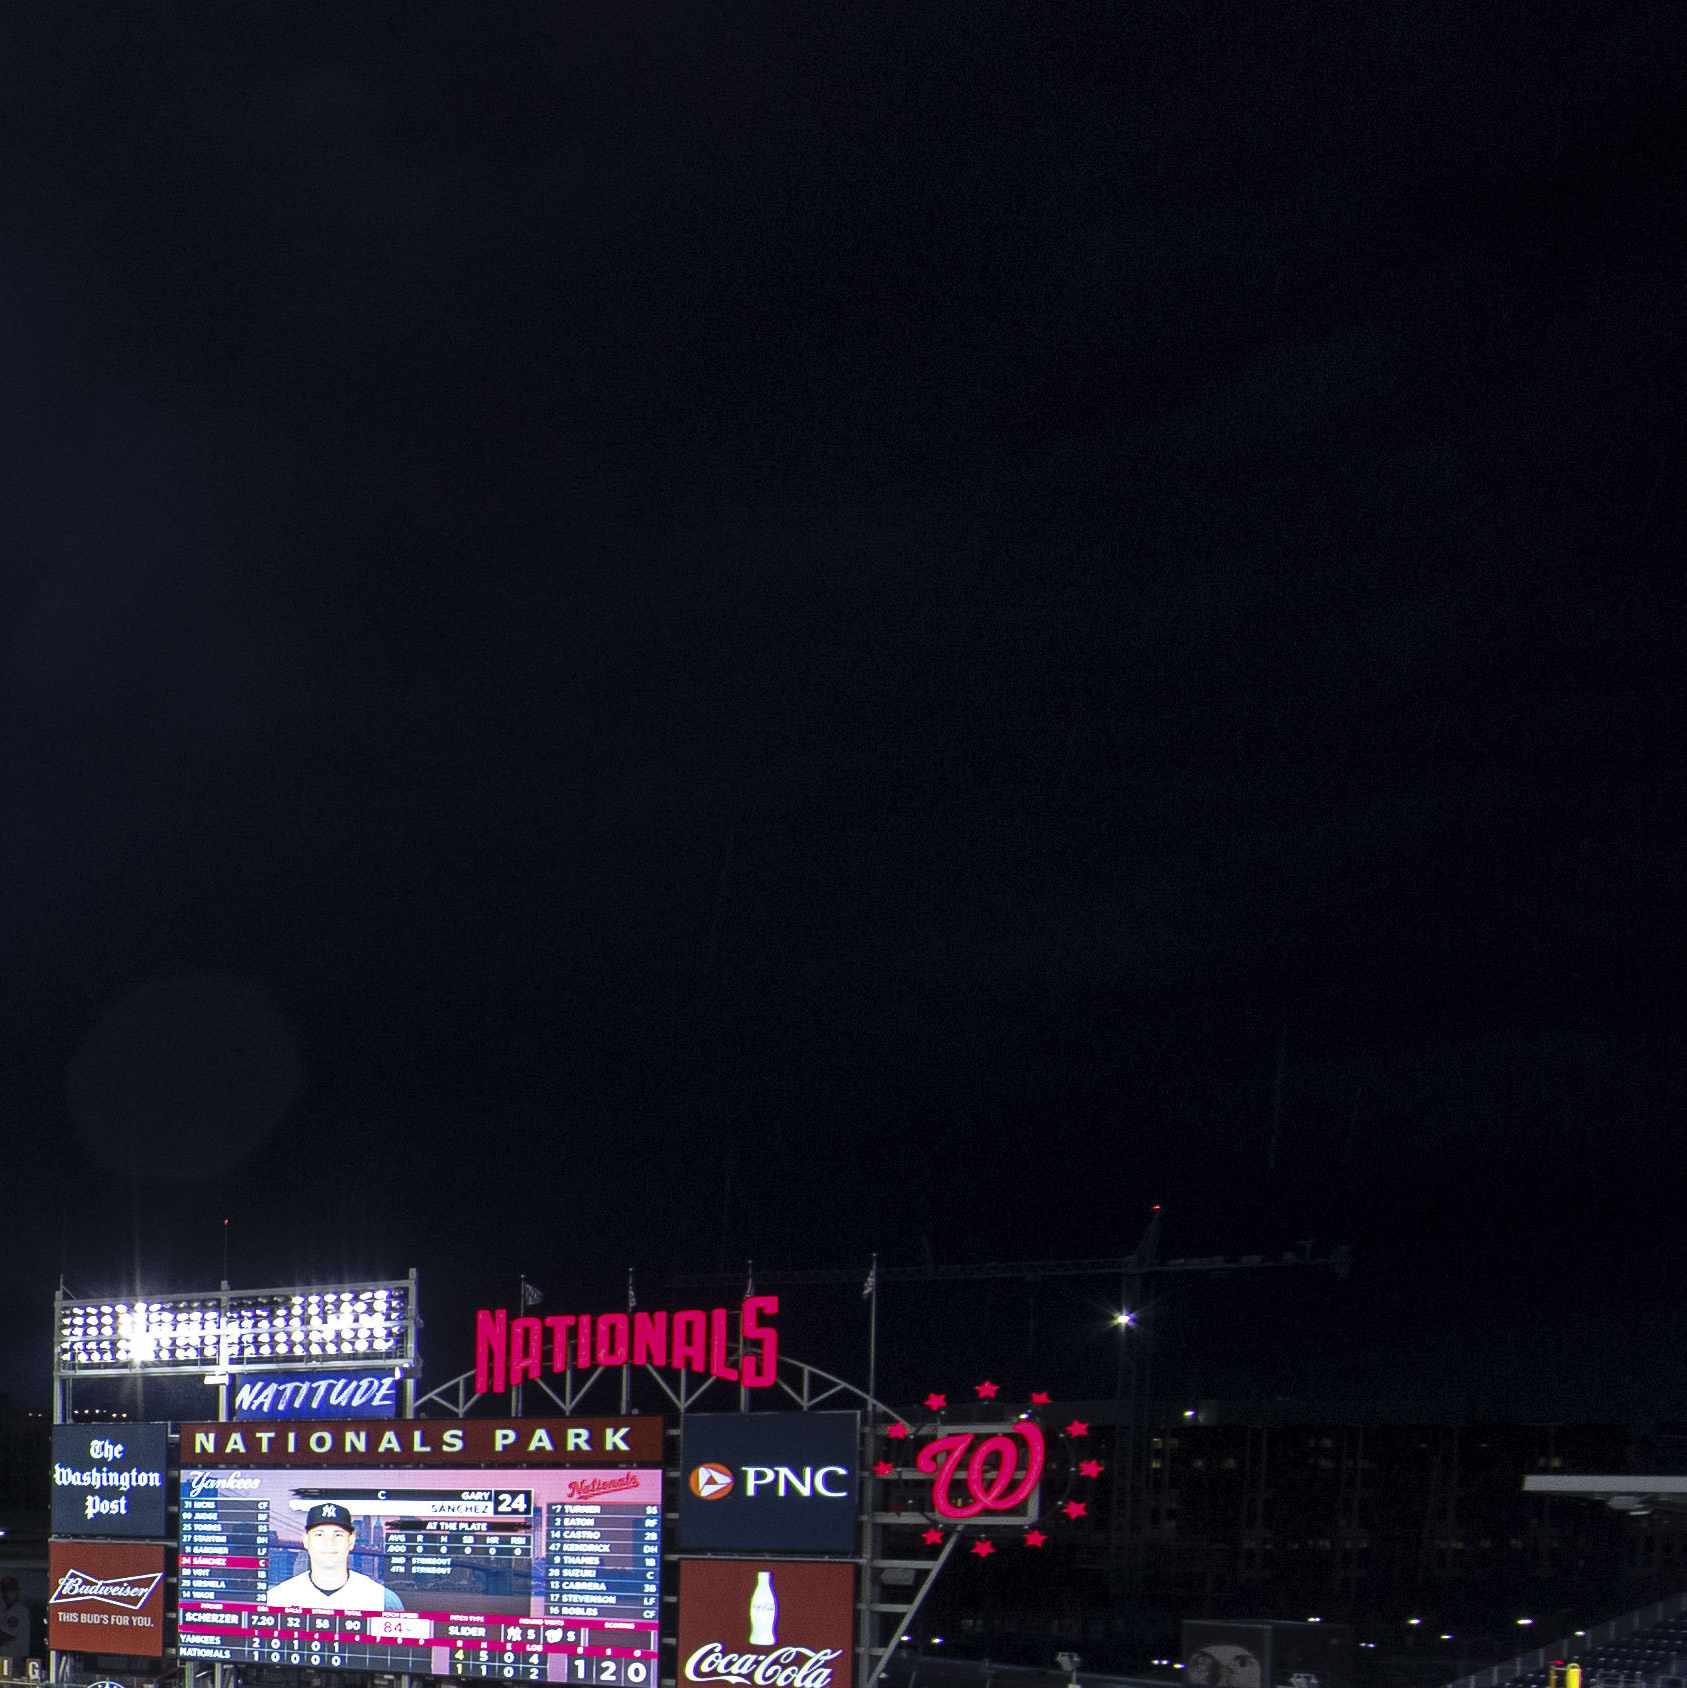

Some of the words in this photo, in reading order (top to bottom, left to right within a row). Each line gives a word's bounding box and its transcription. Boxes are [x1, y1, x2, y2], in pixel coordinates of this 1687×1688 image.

[475, 1295, 779, 1393] NATIONALS
[236, 1378, 396, 1412] NATITUDE
[195, 1430, 464, 1453] NATIONALS
[495, 1428, 632, 1451] PARK
[90, 1439, 123, 1460] The
[54, 1466, 162, 1490] Washington
[190, 1471, 260, 1497] Yankees
[567, 1472, 640, 1500] Nationals
[741, 1466, 848, 1496] PNC
[462, 1492, 490, 1500] GARY
[498, 1494, 527, 1512] 24
[86, 1496, 128, 1518] Post
[565, 1505, 600, 1513] TURNER
[427, 1522, 438, 1530] AT
[439, 1523, 457, 1531] THE
[459, 1523, 487, 1531] PLATE
[563, 1531, 600, 1539] CASTRO
[563, 1544, 610, 1552] KENDRICK
[563, 1557, 599, 1565] THAMES
[59, 1576, 148, 1597] Budweiser
[563, 1582, 606, 1590] CABRERA
[562, 1595, 616, 1604] STEVENSON
[58, 1612, 78, 1623] THIS
[81, 1613, 107, 1625] BUD'S
[111, 1614, 129, 1625] FOR
[131, 1615, 154, 1627] YOU.
[185, 1612, 238, 1624] SCHERZER
[562, 1608, 598, 1616] ROBLES
[251, 1616, 274, 1625] 7.20
[287, 1618, 300, 1627] 32
[345, 1620, 361, 1630] 90
[448, 1626, 486, 1637] SLIDER
[180, 1635, 220, 1644] YANKEES
[253, 1638, 259, 1648] 2
[271, 1639, 280, 1649] 0
[293, 1640, 298, 1650] 1
[311, 1642, 320, 1651] 0
[334, 1643, 339, 1652] 1
[180, 1648, 231, 1658] NATIONALS
[254, 1652, 259, 1661] 1
[271, 1653, 280, 1662] 0
[291, 1654, 300, 1663] 0
[311, 1655, 320, 1665] 0
[331, 1656, 341, 1666] 0
[685, 1642, 843, 1688] Coca-Cola
[575, 1660, 585, 1679] 1
[600, 1661, 616, 1681] 2
[628, 1663, 647, 1682] 0
